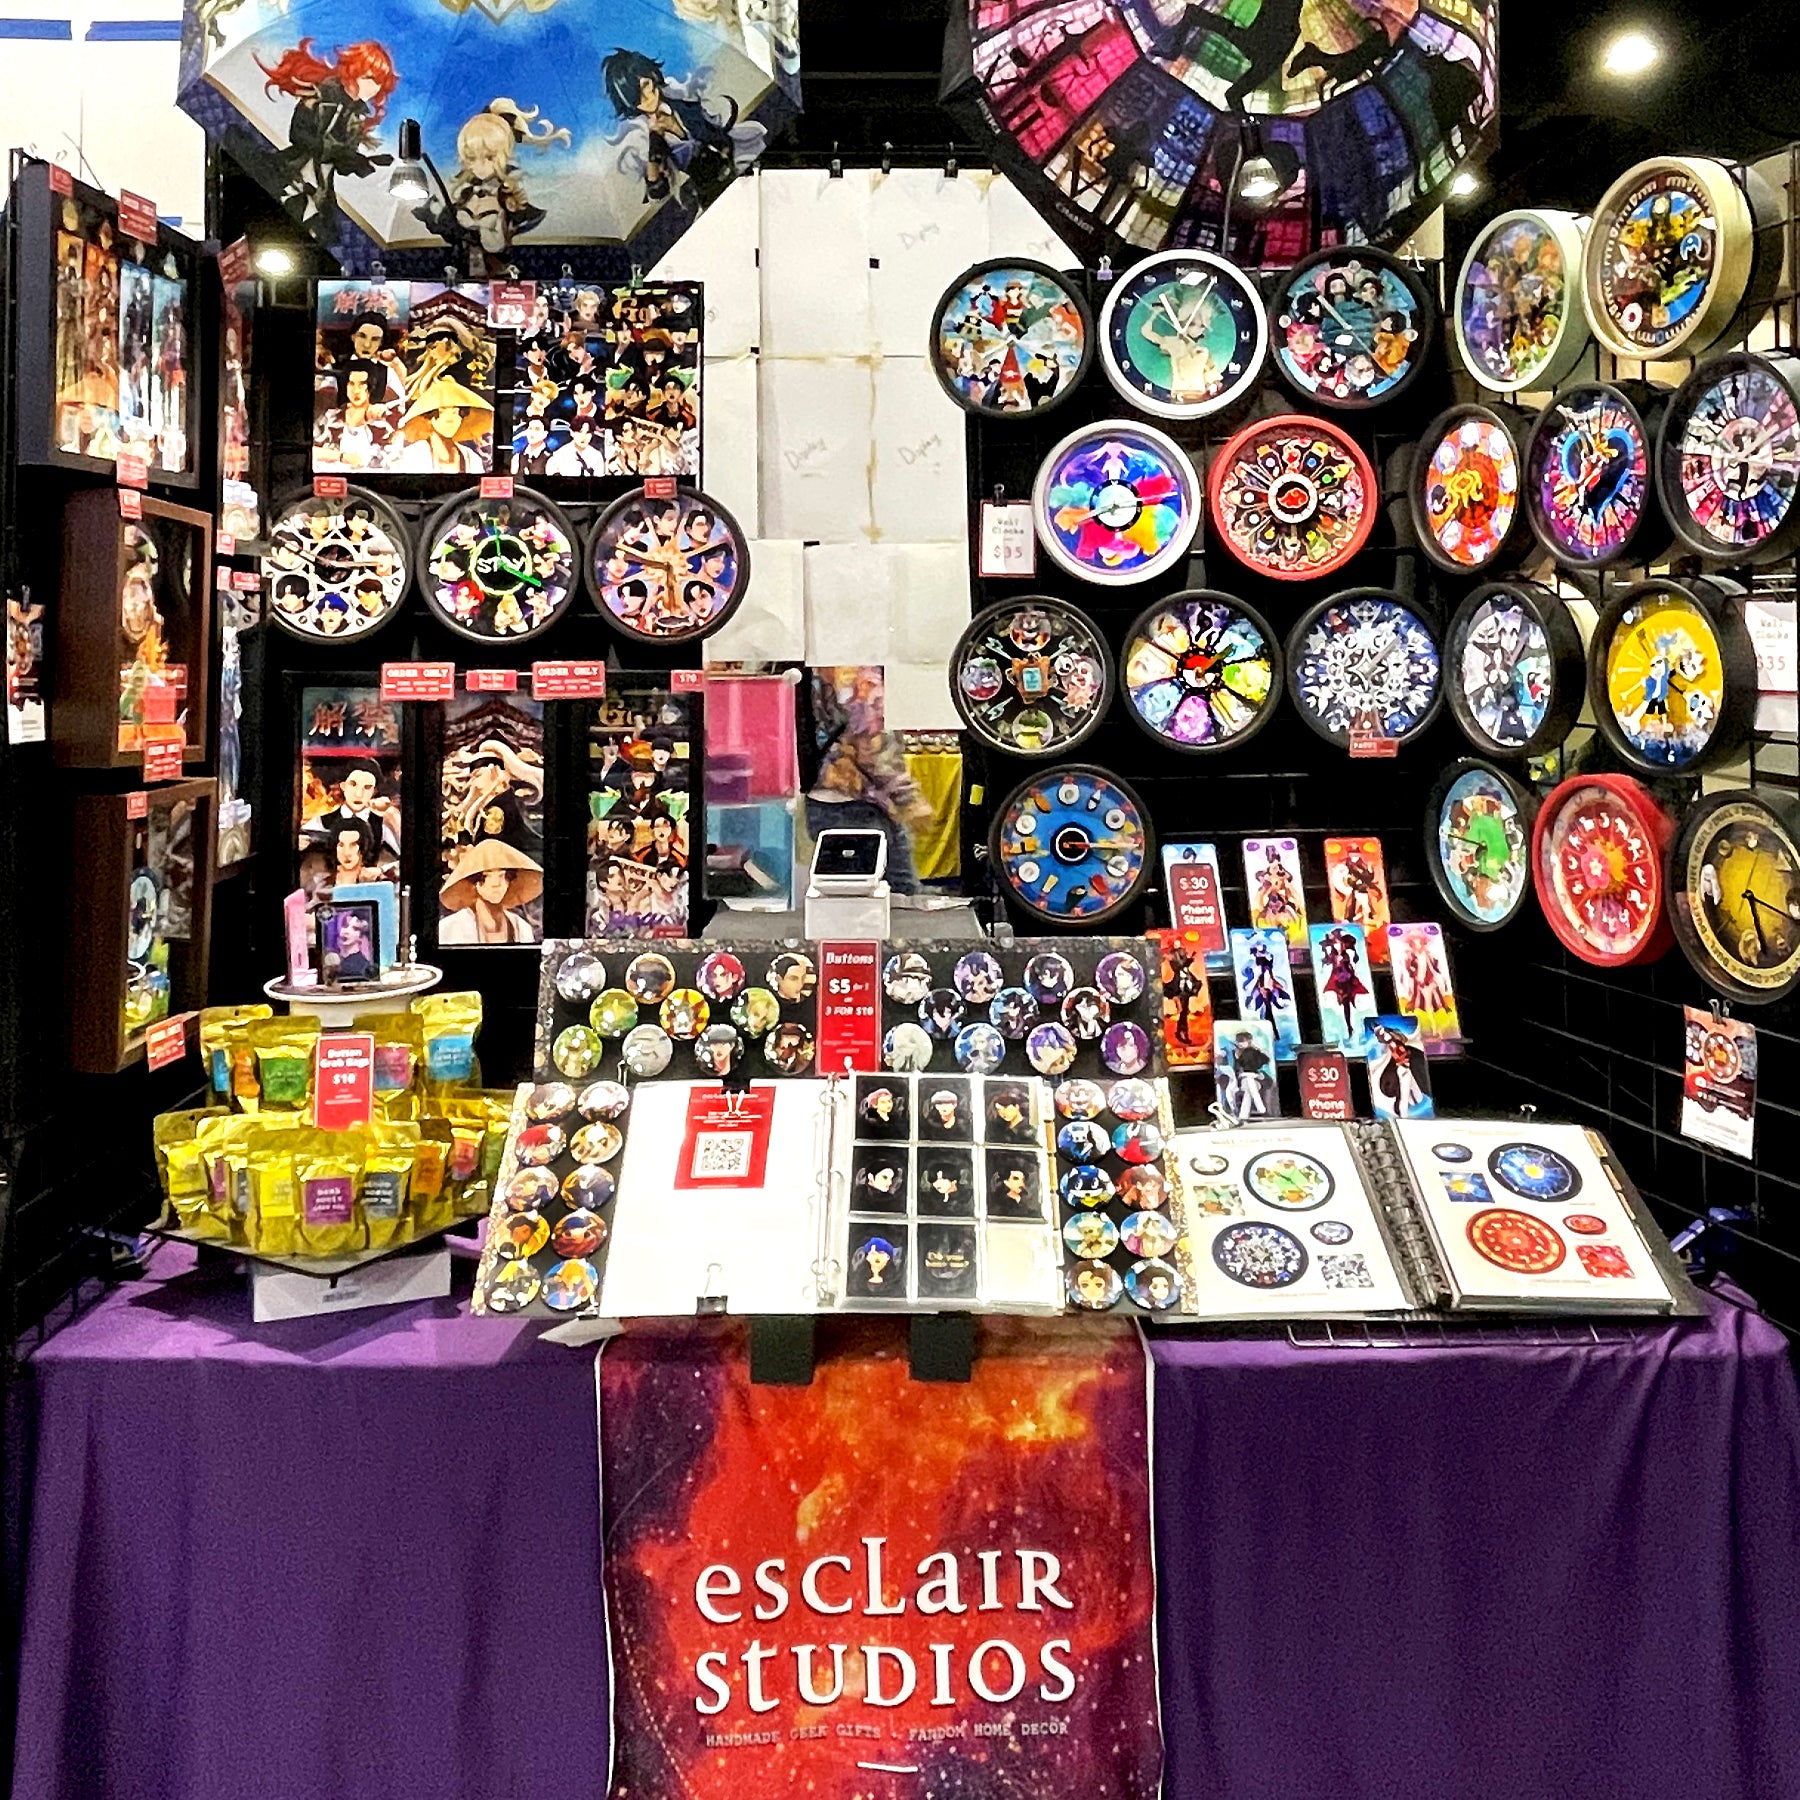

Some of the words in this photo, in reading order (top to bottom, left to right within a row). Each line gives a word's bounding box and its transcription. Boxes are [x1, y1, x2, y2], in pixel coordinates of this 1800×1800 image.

[1181, 904, 1215, 916] Phone
[1183, 914, 1215, 925] Stand
[825, 952, 874, 965] Buttons
[828, 978, 851, 995] $5
[833, 1006, 854, 1016] FOR
[856, 1006, 874, 1016] $10
[327, 1048, 362, 1059] Button
[319, 1058, 345, 1069] Grab
[345, 1057, 370, 1069] Bags
[333, 1072, 356, 1085] $10
[1308, 1098, 1345, 1110] Phone
[706, 1730, 781, 1748] HANDMADE
[790, 1725, 827, 1741] GEEK
[836, 1723, 882, 1739] GIFTS
[908, 1725, 965, 1742] FANDOM
[973, 1723, 1011, 1738] HOME
[1021, 1721, 1069, 1736] DECOR
